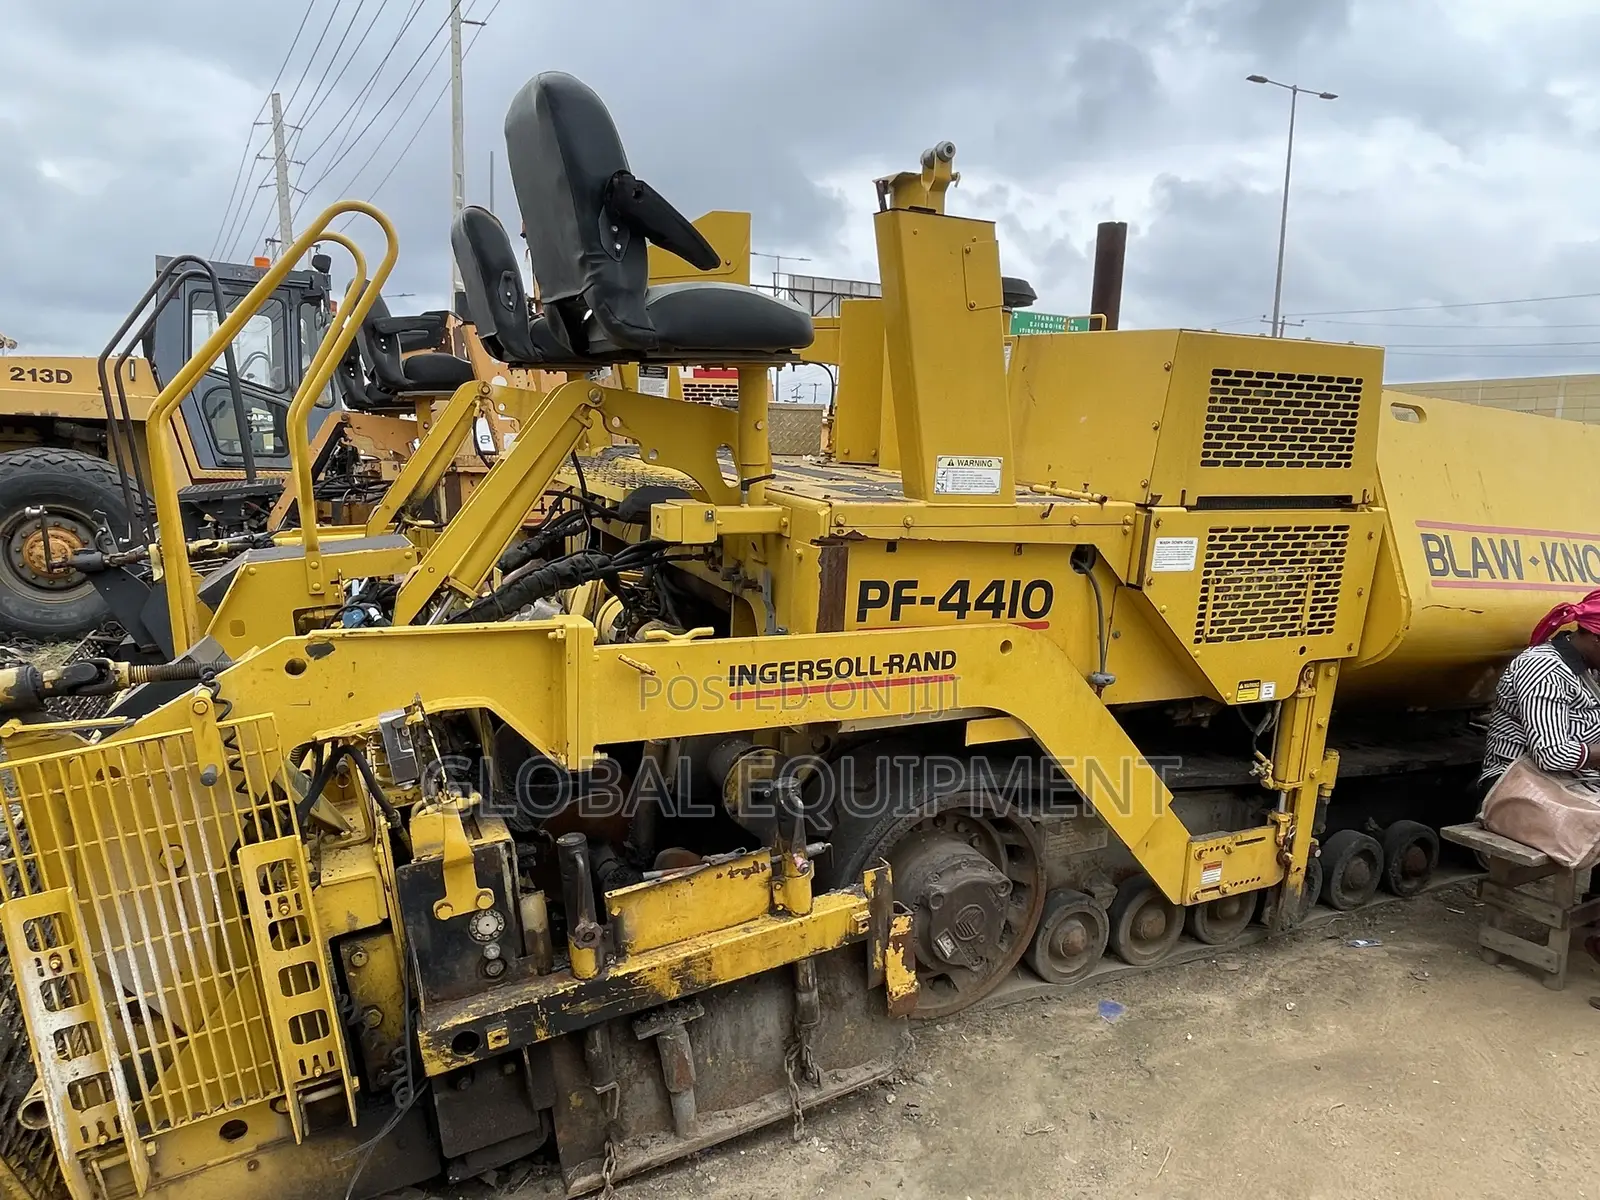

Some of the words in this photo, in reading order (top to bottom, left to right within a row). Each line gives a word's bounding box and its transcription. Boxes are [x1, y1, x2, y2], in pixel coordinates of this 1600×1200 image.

[1029, 321, 1079, 331] EJIGBO/IKOUN
[1034, 314, 1054, 322] IYANA
[1056, 316, 1075, 324] IPAA
[9, 366, 73, 384] 213D
[957, 459, 993, 467] WARNING
[1420, 533, 1524, 580] BLAW
[856, 579, 1054, 623] PF-4410
[728, 650, 957, 687] INGERSOLL-RAND
